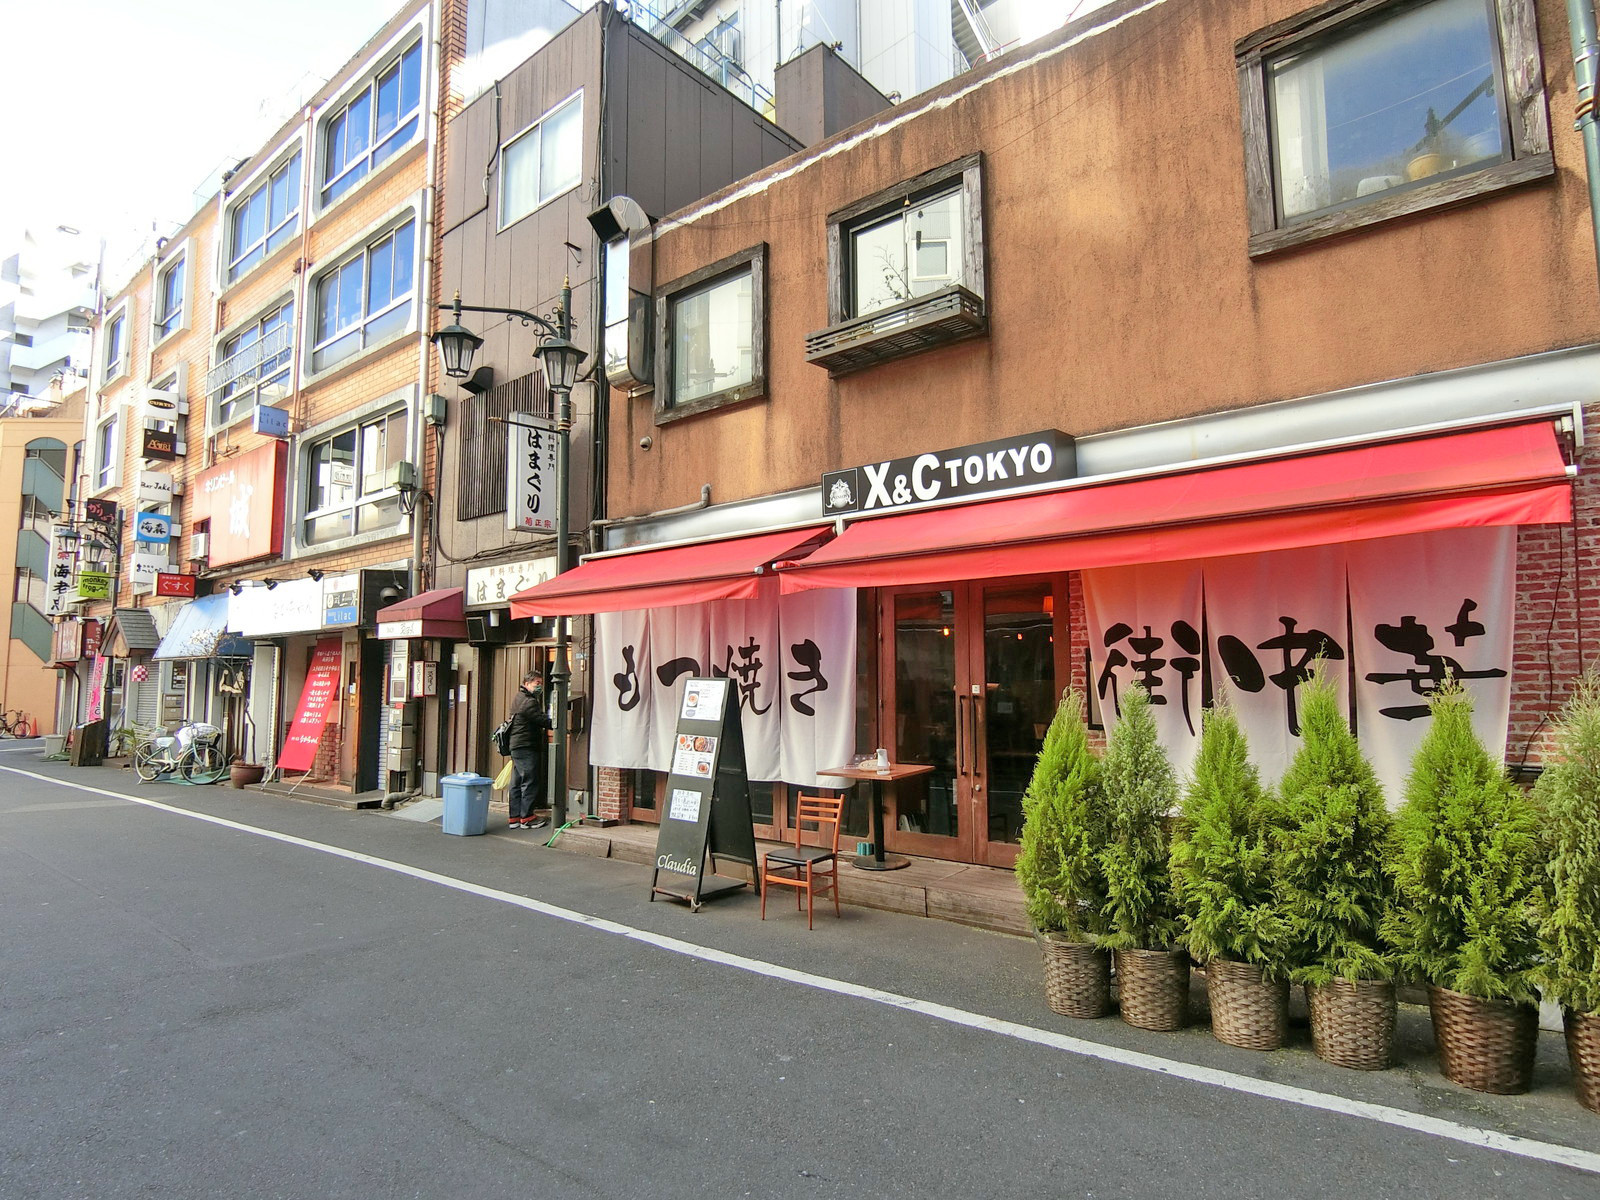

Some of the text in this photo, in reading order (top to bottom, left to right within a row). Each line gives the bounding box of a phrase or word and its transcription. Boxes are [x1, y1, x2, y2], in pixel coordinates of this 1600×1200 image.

[526, 428, 542, 514] はまぐり
[863, 442, 1053, 509] X&C TOKYO
[163, 581, 190, 591] ぐすく
[657, 853, 697, 876] Claudia
